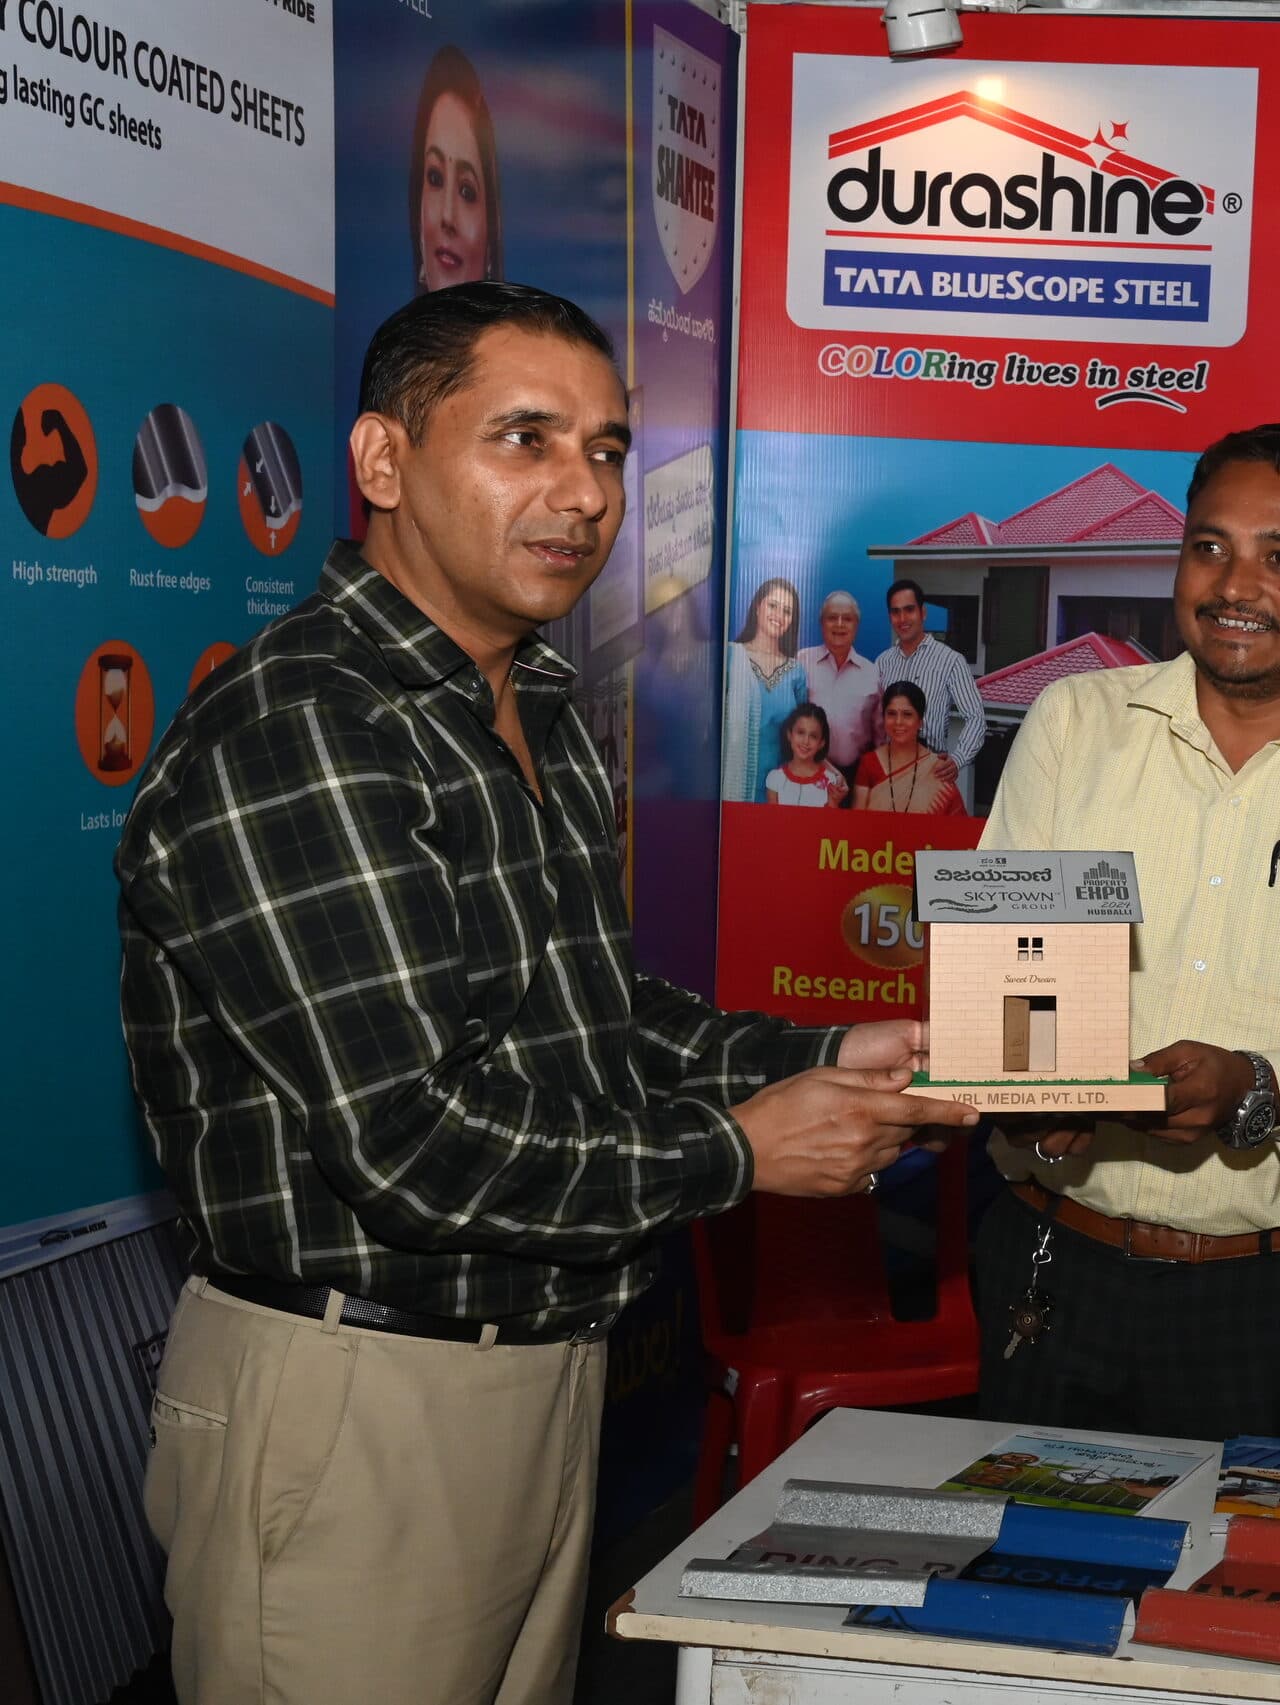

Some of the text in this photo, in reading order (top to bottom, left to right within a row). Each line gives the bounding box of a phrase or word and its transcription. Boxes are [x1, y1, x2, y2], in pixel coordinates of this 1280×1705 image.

[273, 0, 315, 24] RIDE
[18, 0, 128, 79] COLOUR
[134, 41, 225, 115] COATED
[231, 80, 305, 146] SHEETS
[13, 63, 75, 128] lasting
[80, 92, 105, 130] GC
[109, 103, 162, 150] sheets
[667, 94, 707, 149] TATA
[656, 144, 715, 223] SHAKTEE
[827, 147, 1205, 236] durashine
[834, 267, 923, 296] TATA
[1113, 279, 1200, 308] STEEL
[820, 345, 1208, 392] COLORing lives in steel
[12, 561, 97, 586] High strength
[130, 569, 211, 593] Rust free edges
[245, 577, 294, 596] Consistent
[81, 812, 110, 831] Lasts
[818, 838, 914, 876] Made
[934, 868, 1052, 882] ವಿಜಯವಾಣಿ
[1083, 879, 1127, 887] PROPERTY
[964, 891, 1054, 902] SKYTOWN
[1087, 908, 1133, 916] HUBBALLI
[772, 965, 916, 1005] Research
[1004, 973, 1057, 984] Sweet Dream
[952, 1092, 1109, 1106] VRL MEDIA PVT. LTD.
